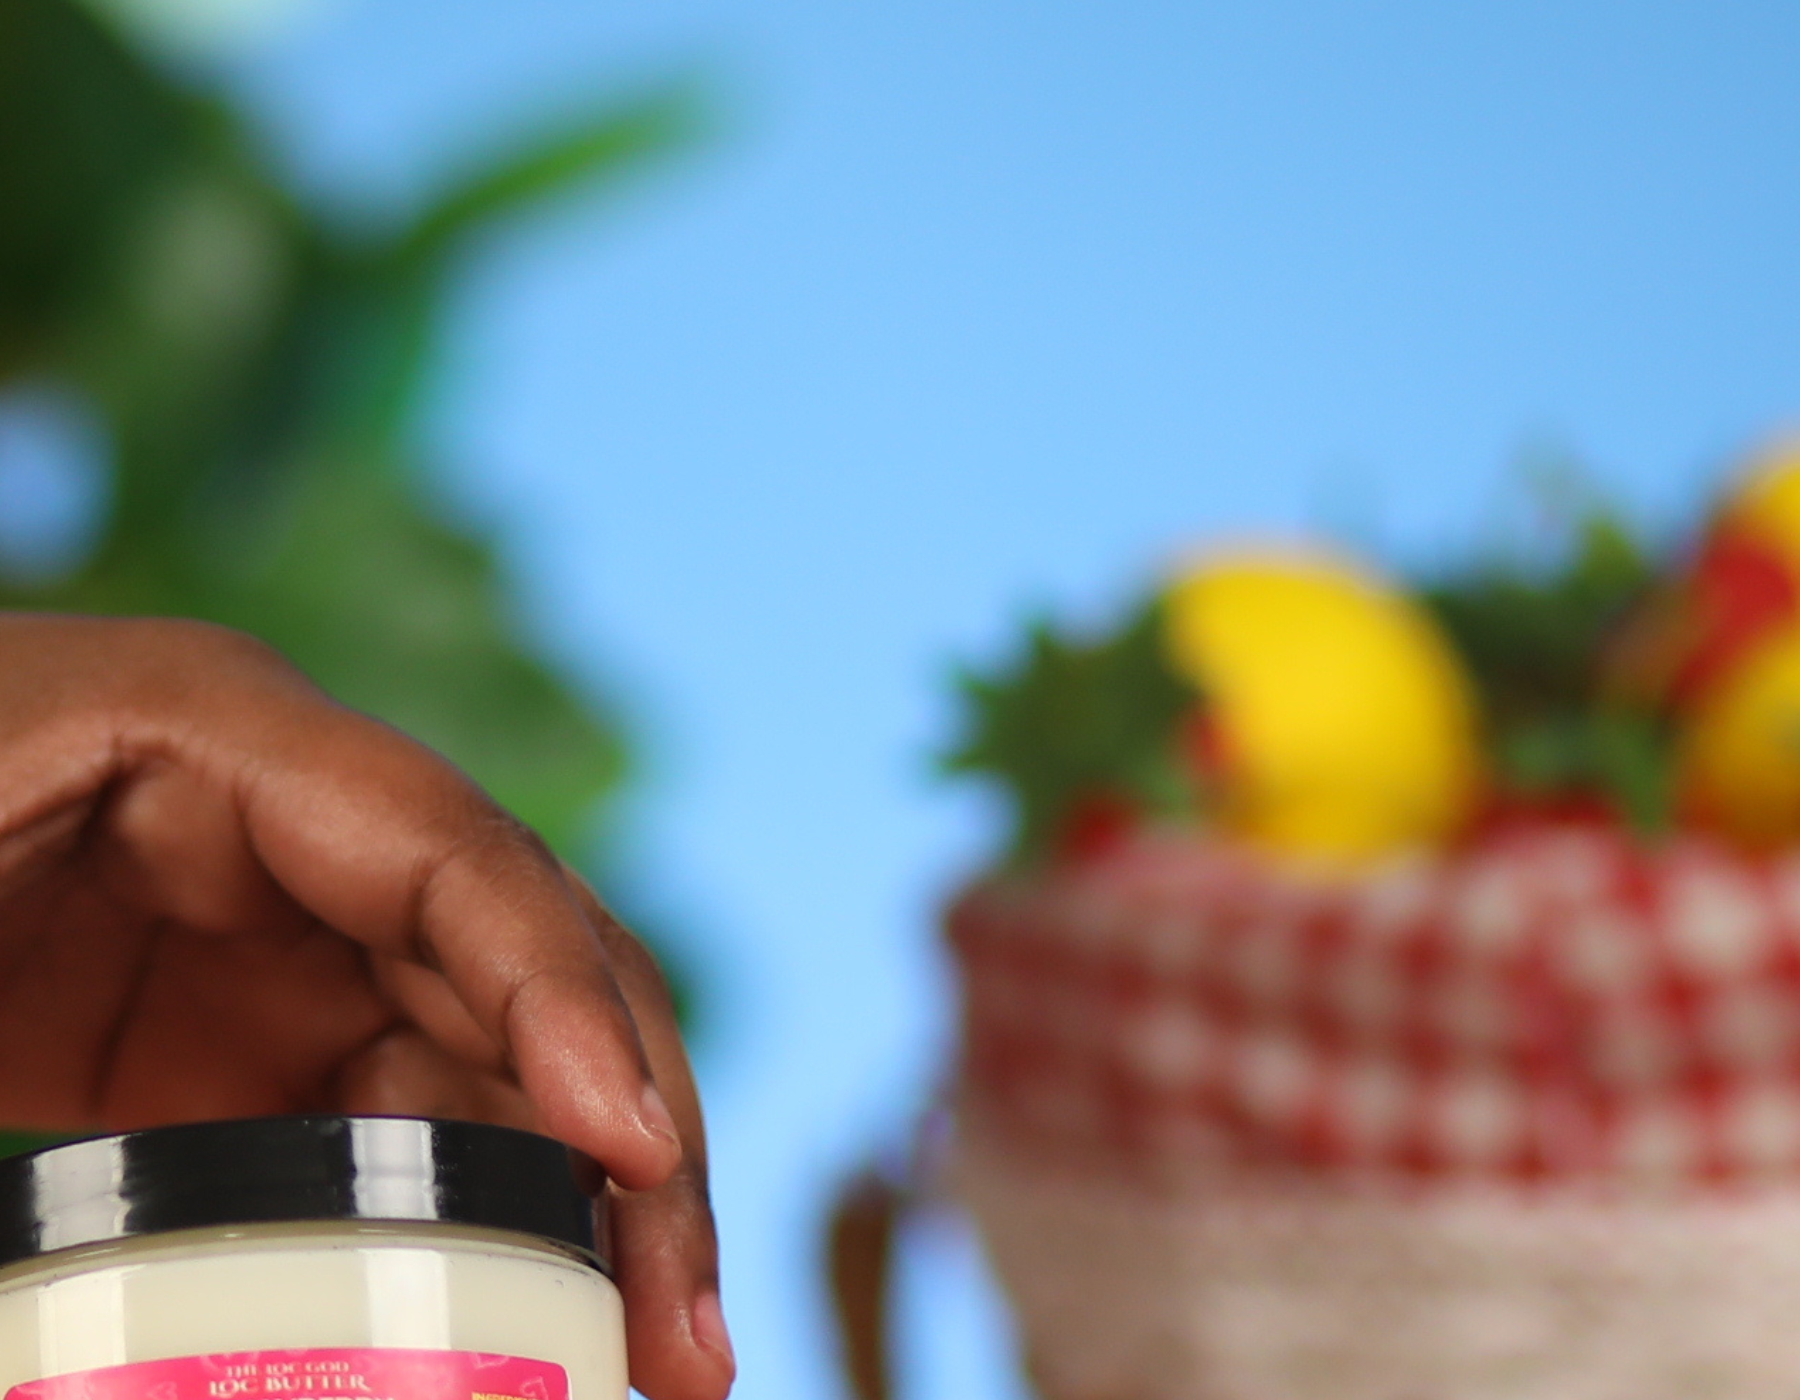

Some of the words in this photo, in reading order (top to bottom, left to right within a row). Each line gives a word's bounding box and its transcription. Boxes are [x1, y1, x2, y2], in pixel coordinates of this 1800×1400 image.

[305, 1361, 349, 1373] GOD
[209, 1379, 258, 1398] LOC
[266, 1375, 372, 1392] BUTTER
